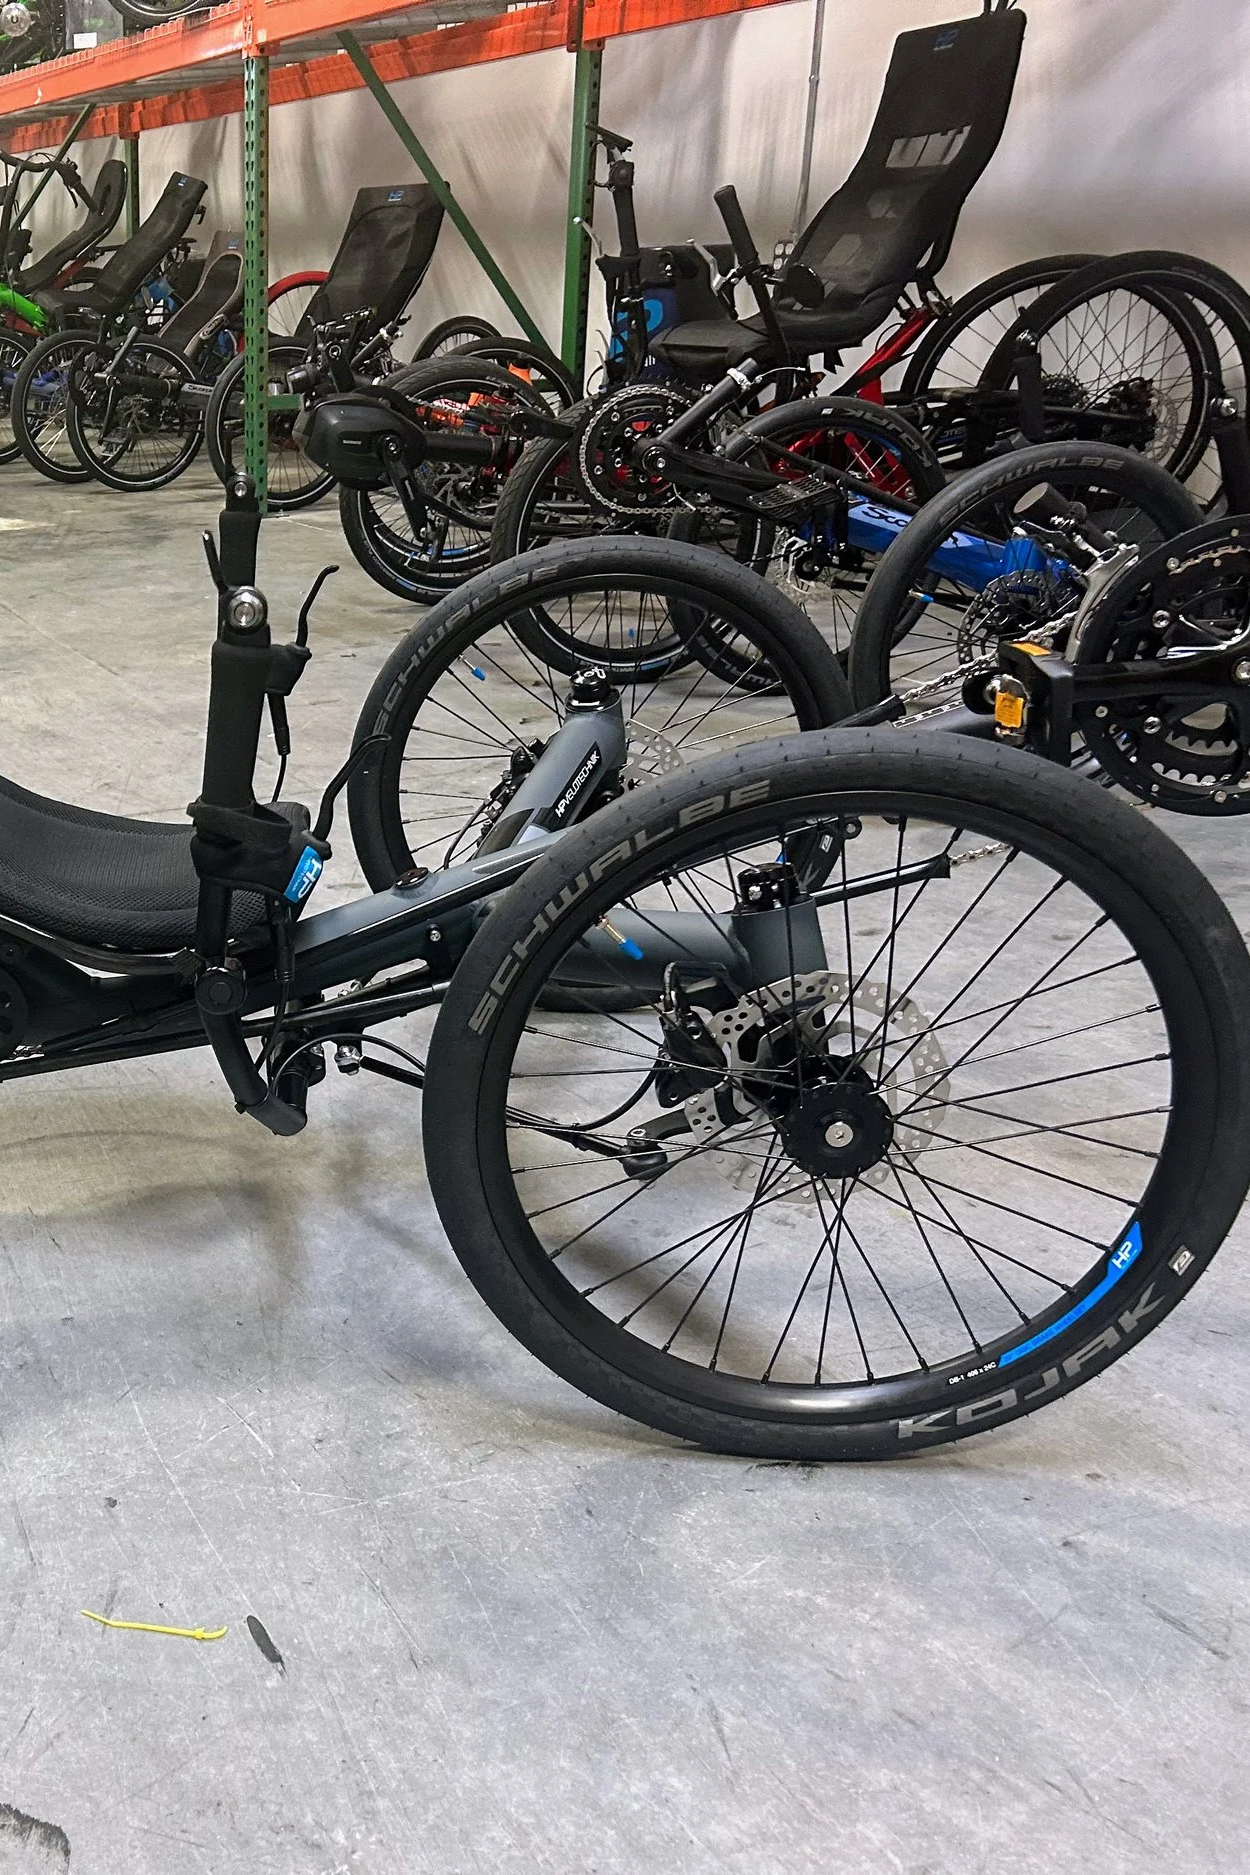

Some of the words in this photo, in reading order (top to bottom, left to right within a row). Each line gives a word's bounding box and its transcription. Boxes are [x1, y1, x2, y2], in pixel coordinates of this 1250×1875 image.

[841, 407, 932, 468] KOJAK
[939, 456, 1125, 526] SCHWALBE
[372, 564, 559, 736] SCHWALBE
[297, 858, 323, 899] HP
[468, 780, 770, 1035] SCHWALBE
[1111, 1241, 1133, 1270] HP
[898, 1282, 1166, 1439] KOJAK
[949, 1374, 966, 1386] DB-1
[983, 1361, 998, 1373] 24C
